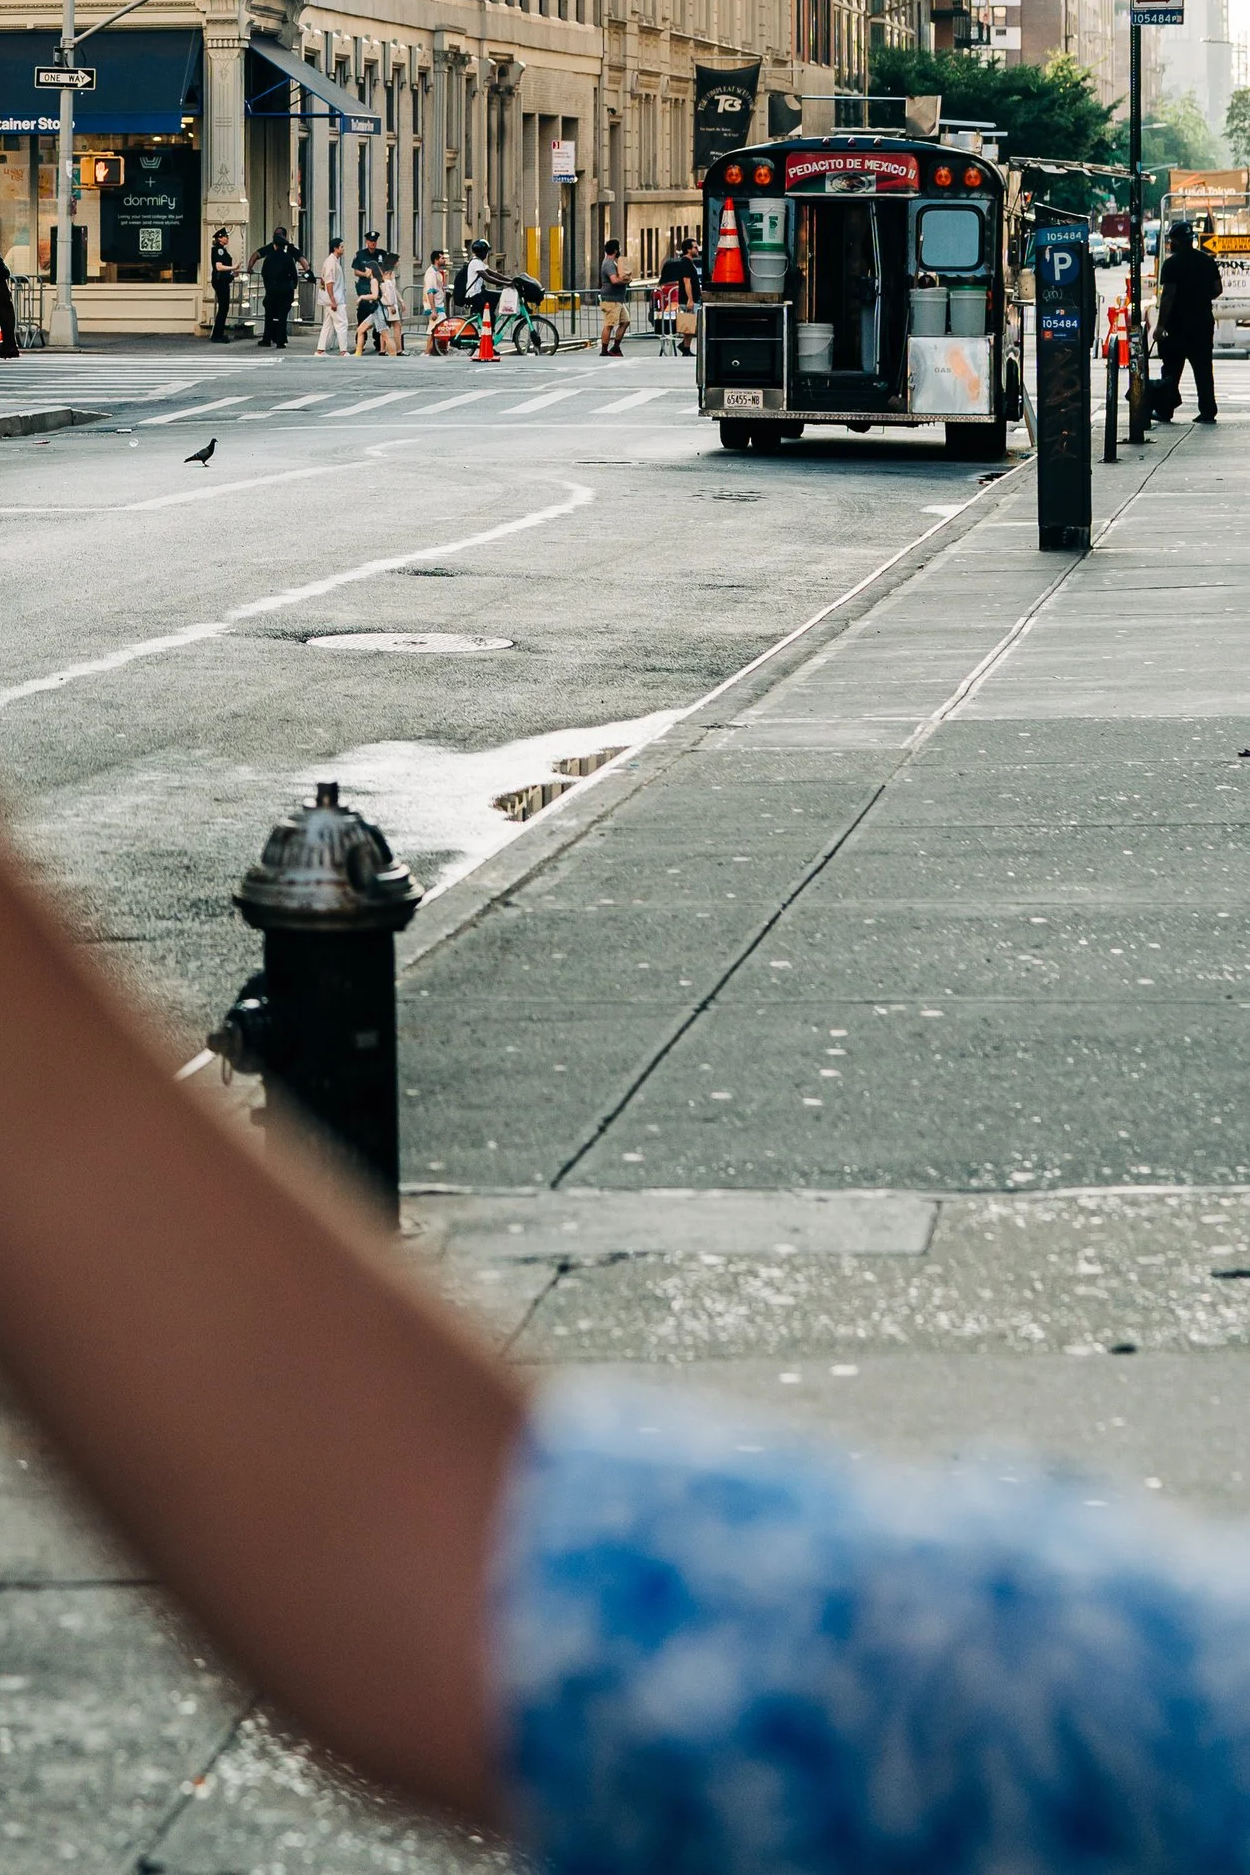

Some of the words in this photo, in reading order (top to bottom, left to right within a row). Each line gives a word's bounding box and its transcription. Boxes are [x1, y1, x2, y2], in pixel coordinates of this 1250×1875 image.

[1134, 14, 1172, 23] 105484
[44, 73, 61, 82] ONE
[68, 74, 86, 82] WAY
[37, 117, 75, 130] Sto
[788, 158, 844, 178] PEDACITO
[846, 158, 862, 169] DE
[864, 159, 906, 176] MEXICO
[123, 194, 176, 209] dormify
[1046, 231, 1082, 241] 105484
[1053, 252, 1072, 281] P
[1042, 319, 1078, 328] 105484
